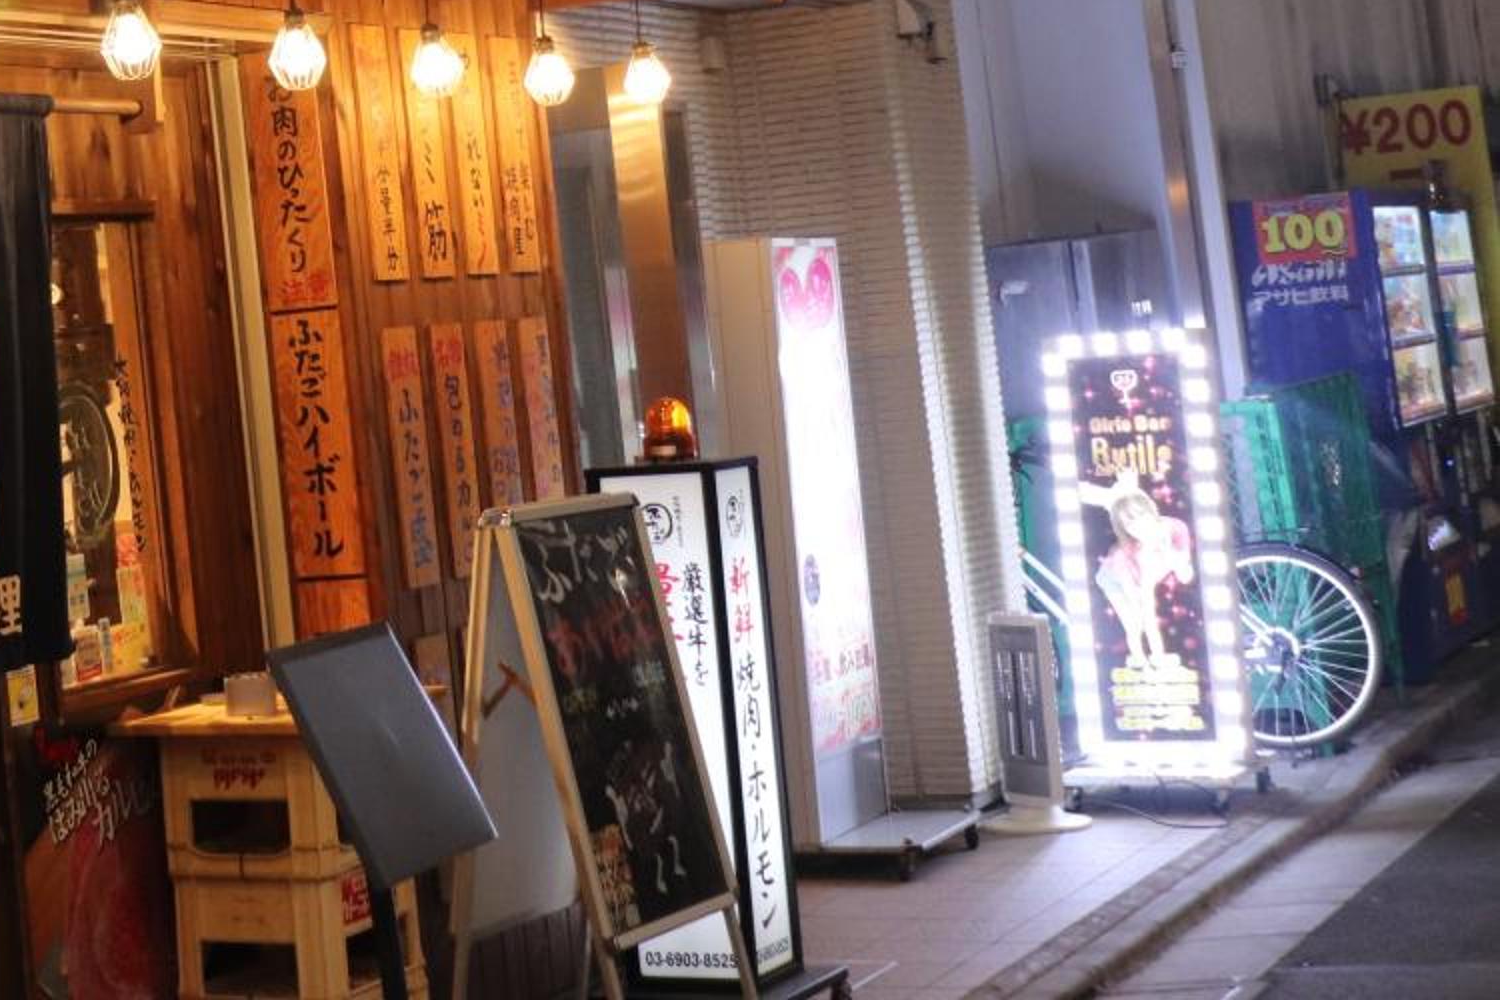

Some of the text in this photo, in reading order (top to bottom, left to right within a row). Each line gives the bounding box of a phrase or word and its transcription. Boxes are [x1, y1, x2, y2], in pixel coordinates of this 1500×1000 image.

[1261, 210, 1345, 254] 100
[288, 319, 345, 560] ふたごハイボール
